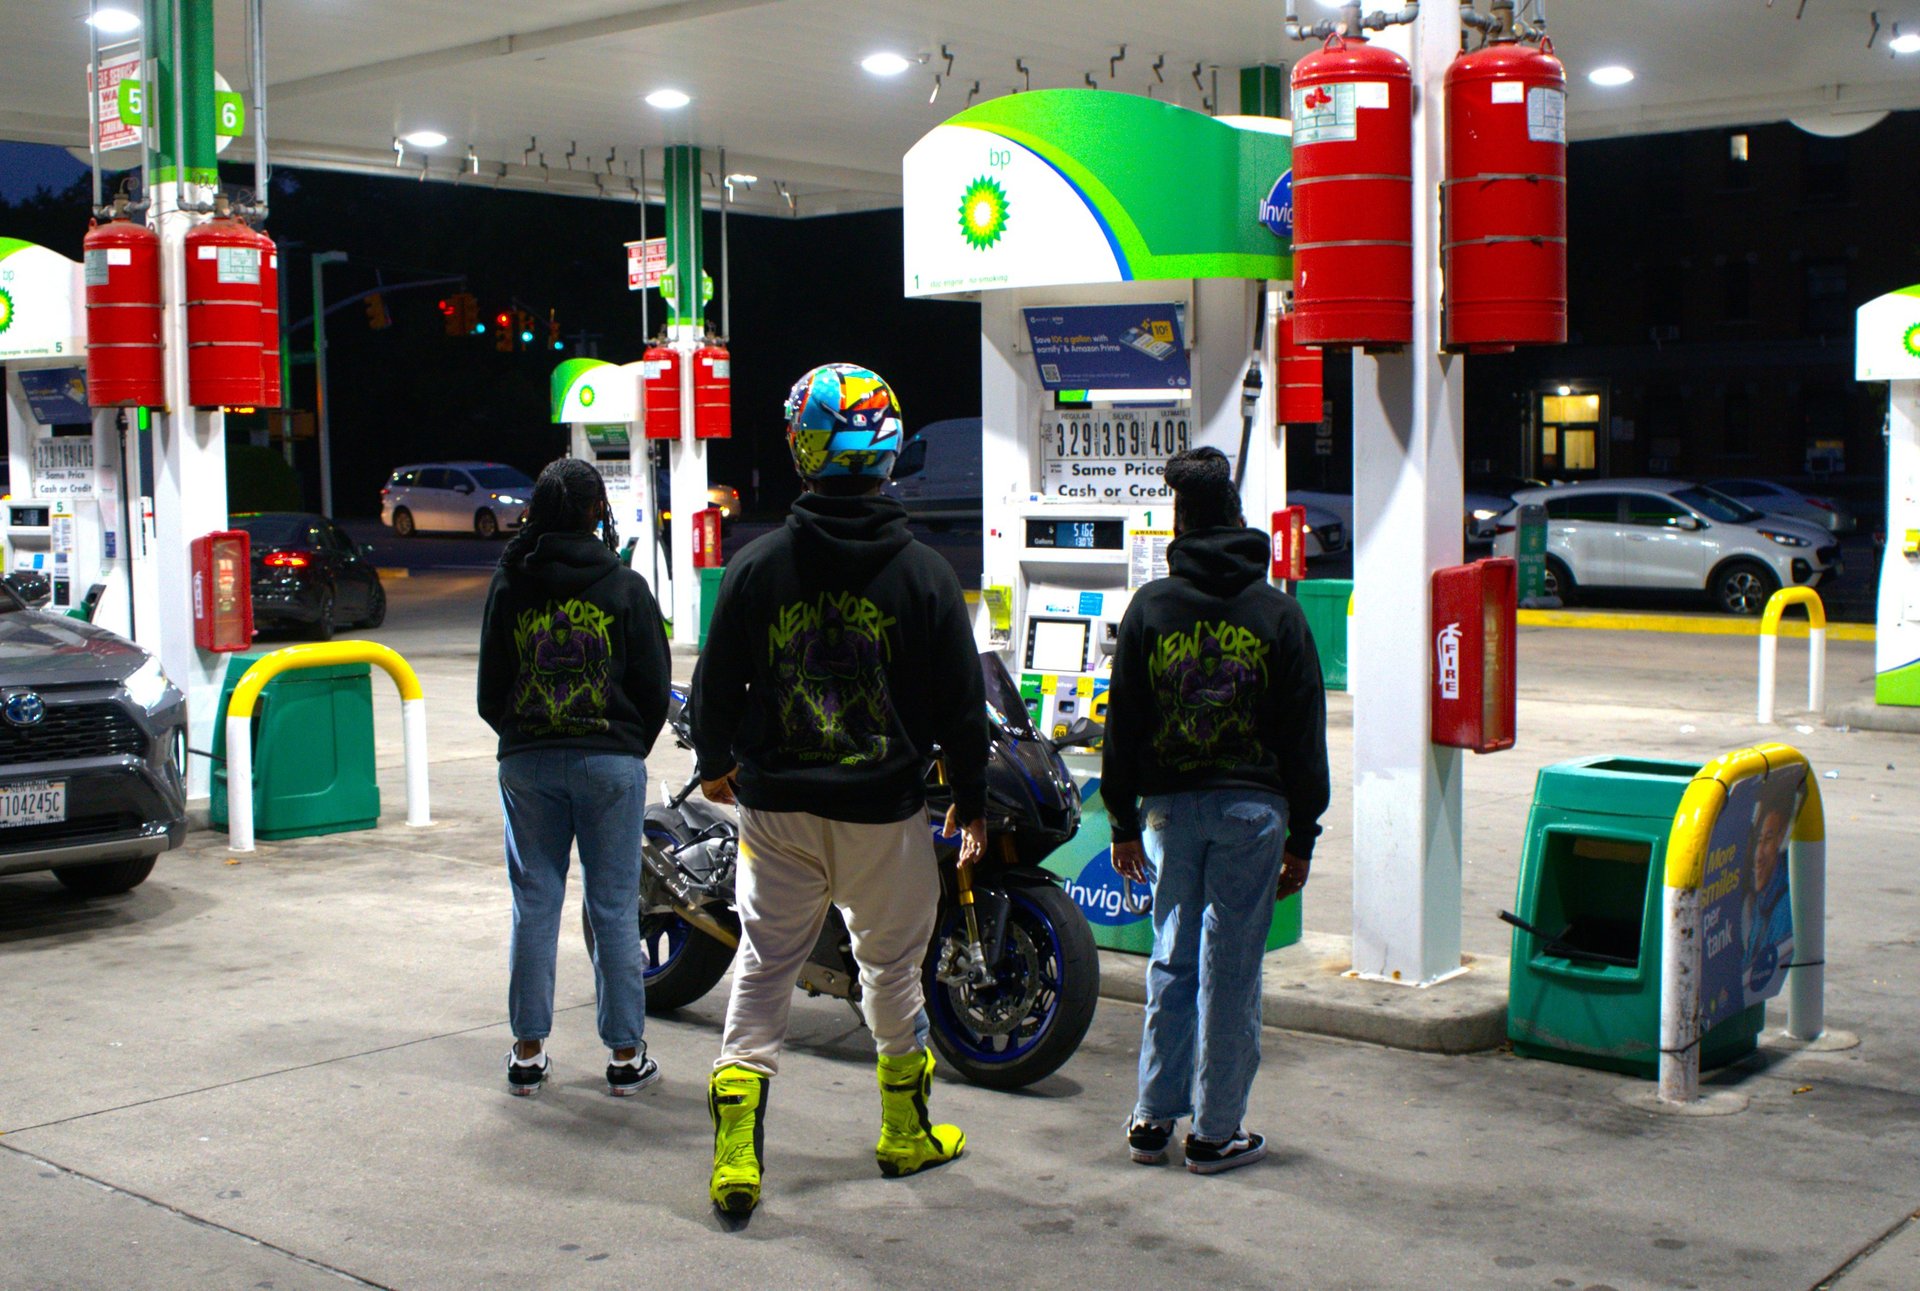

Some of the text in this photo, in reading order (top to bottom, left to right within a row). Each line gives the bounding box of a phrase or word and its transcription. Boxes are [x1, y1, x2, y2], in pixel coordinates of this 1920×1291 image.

[128, 88, 142, 114] 5
[222, 103, 236, 128] 6
[989, 147, 1011, 170] bp
[1260, 199, 1293, 229] Invig
[663, 280, 673, 293] 11
[914, 274, 919, 290] 1
[55, 341, 63, 353] 5
[1034, 335, 1051, 344] Save
[1070, 335, 1092, 345] gallon
[1092, 334, 1109, 343] with
[1071, 345, 1099, 353] Amazon
[1100, 344, 1120, 352] Prime
[1057, 421, 1091, 457] 3.29
[1102, 420, 1139, 456] 3.69
[1151, 419, 1188, 456] 4.09
[45, 470, 85, 479] Same Price
[1072, 463, 1117, 476] Same
[1125, 462, 1165, 476] Price
[40, 484, 57, 493] Cash
[70, 483, 92, 493] Credit
[1058, 483, 1173, 497] Cash or Credi
[56, 501, 63, 512] 5
[1144, 510, 1152, 527] 1
[1034, 537, 1054, 545] Gallons
[513, 596, 615, 660] NEW YORK
[768, 589, 897, 667] NEW YORK
[1148, 618, 1271, 690] NEW YORK
[1444, 643, 1457, 692] FIRE
[1707, 843, 1737, 874] More
[1064, 880, 1151, 917] Invigor
[1701, 868, 1740, 909] smiles
[1703, 906, 1721, 938] per
[1707, 919, 1733, 960] tank
